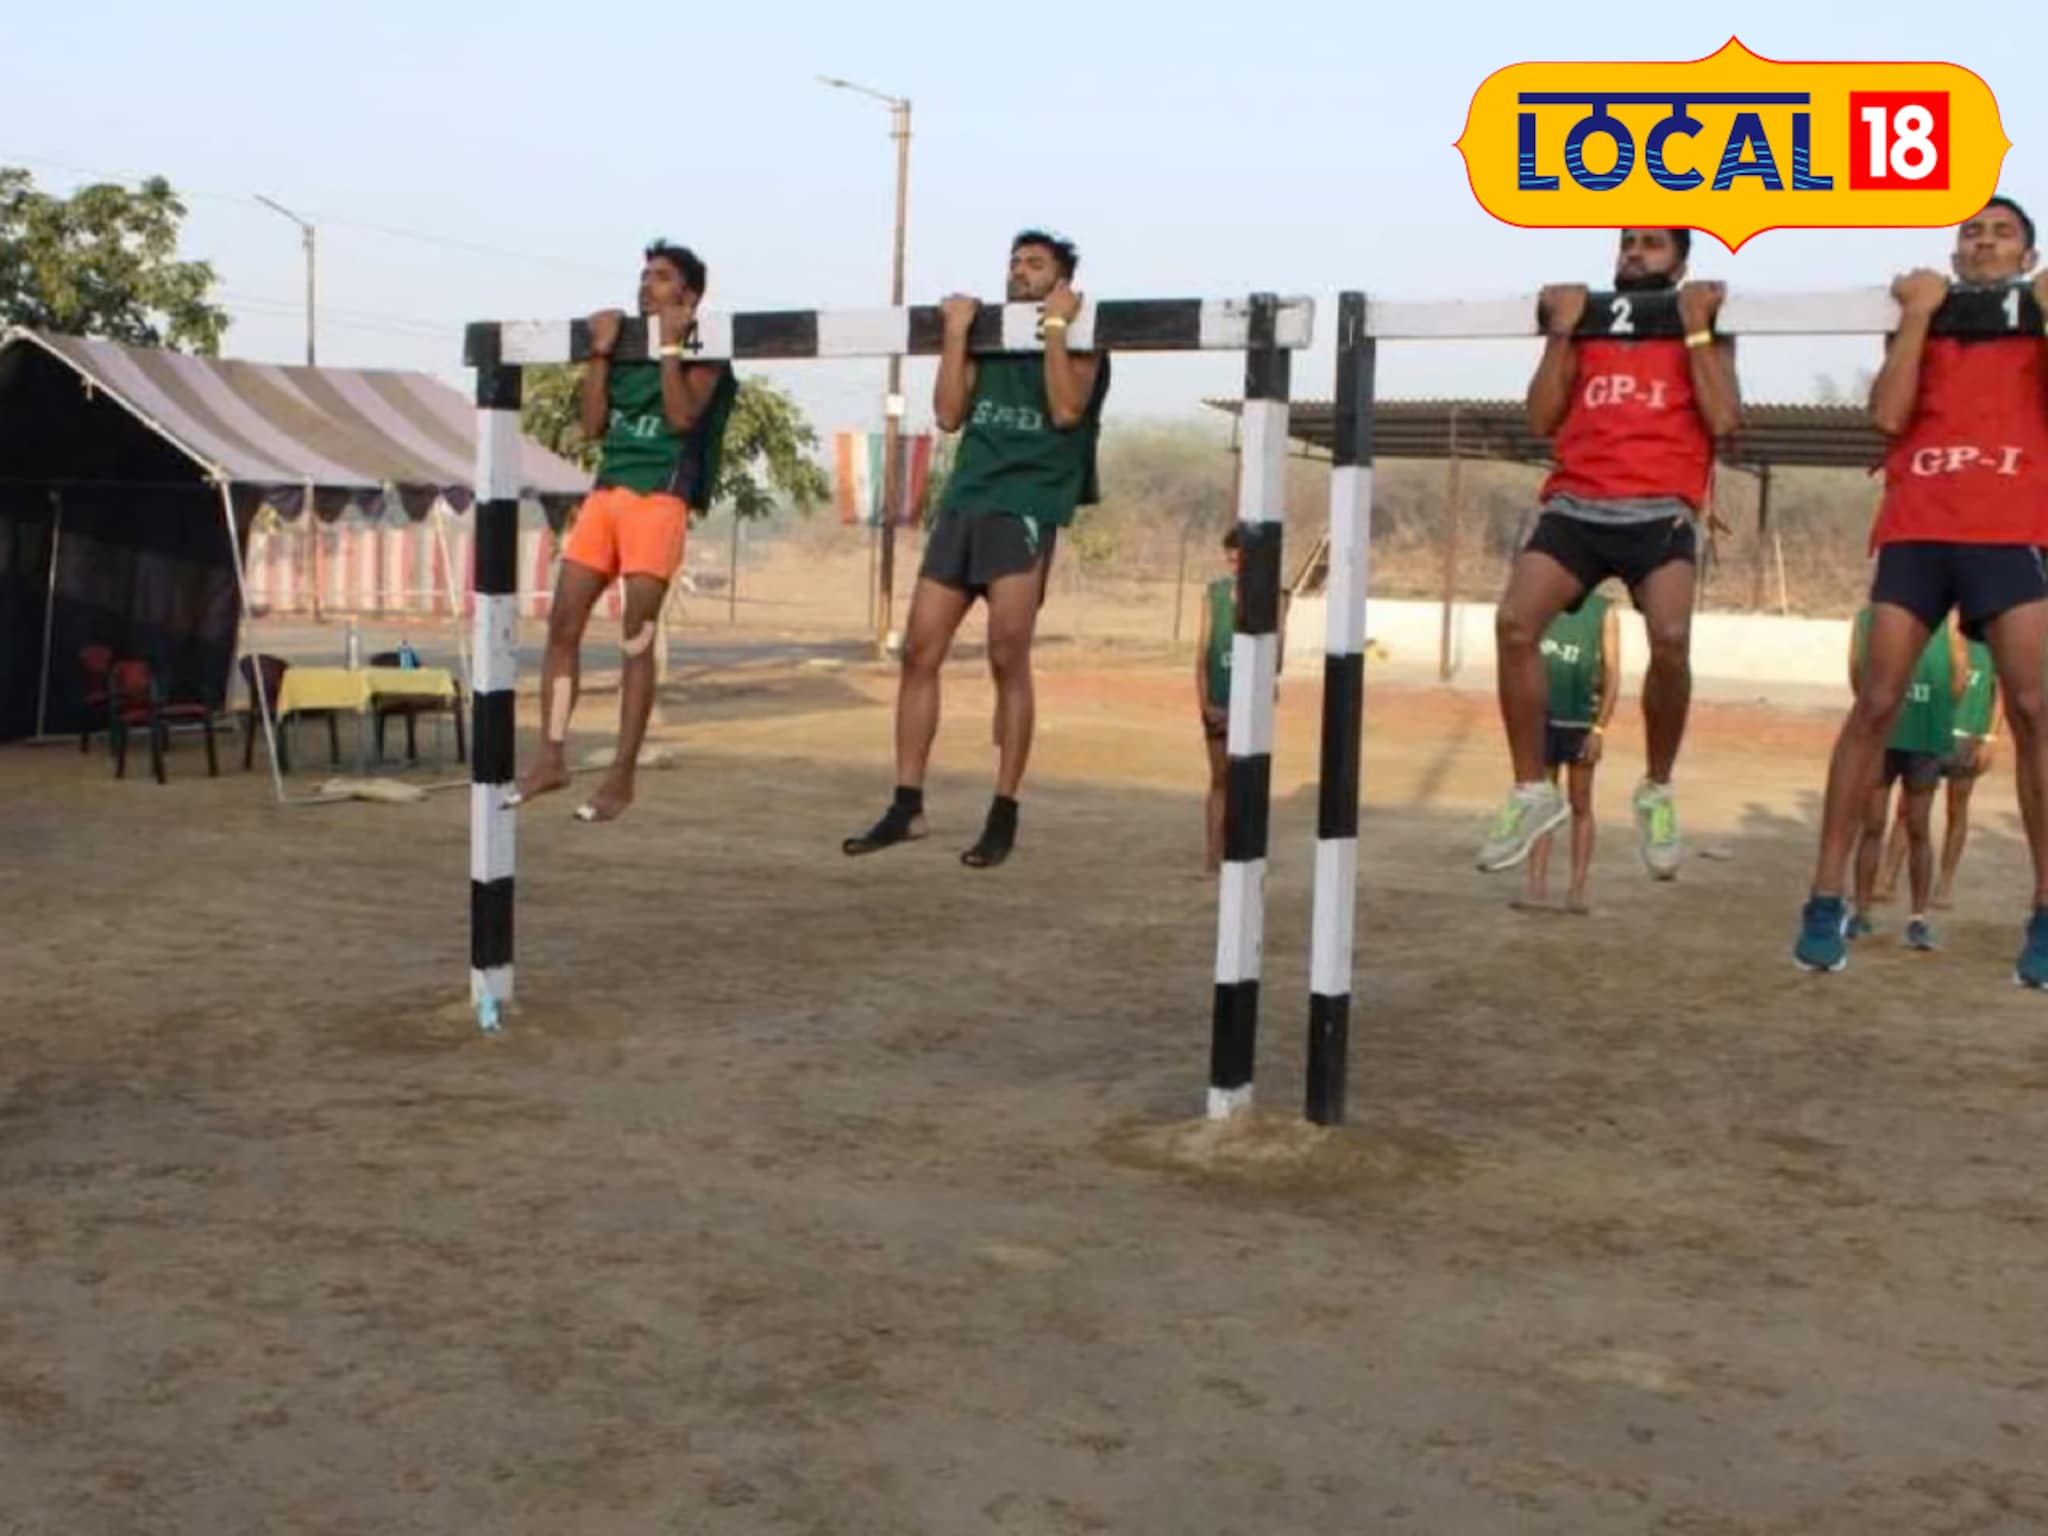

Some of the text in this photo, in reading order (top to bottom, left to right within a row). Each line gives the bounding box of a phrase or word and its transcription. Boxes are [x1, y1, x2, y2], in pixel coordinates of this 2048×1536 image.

[1609, 297, 1634, 334] 2
[2002, 287, 2020, 328] 1
[1584, 373, 1668, 409] GP-I
[1910, 445, 2023, 477] GP-I
